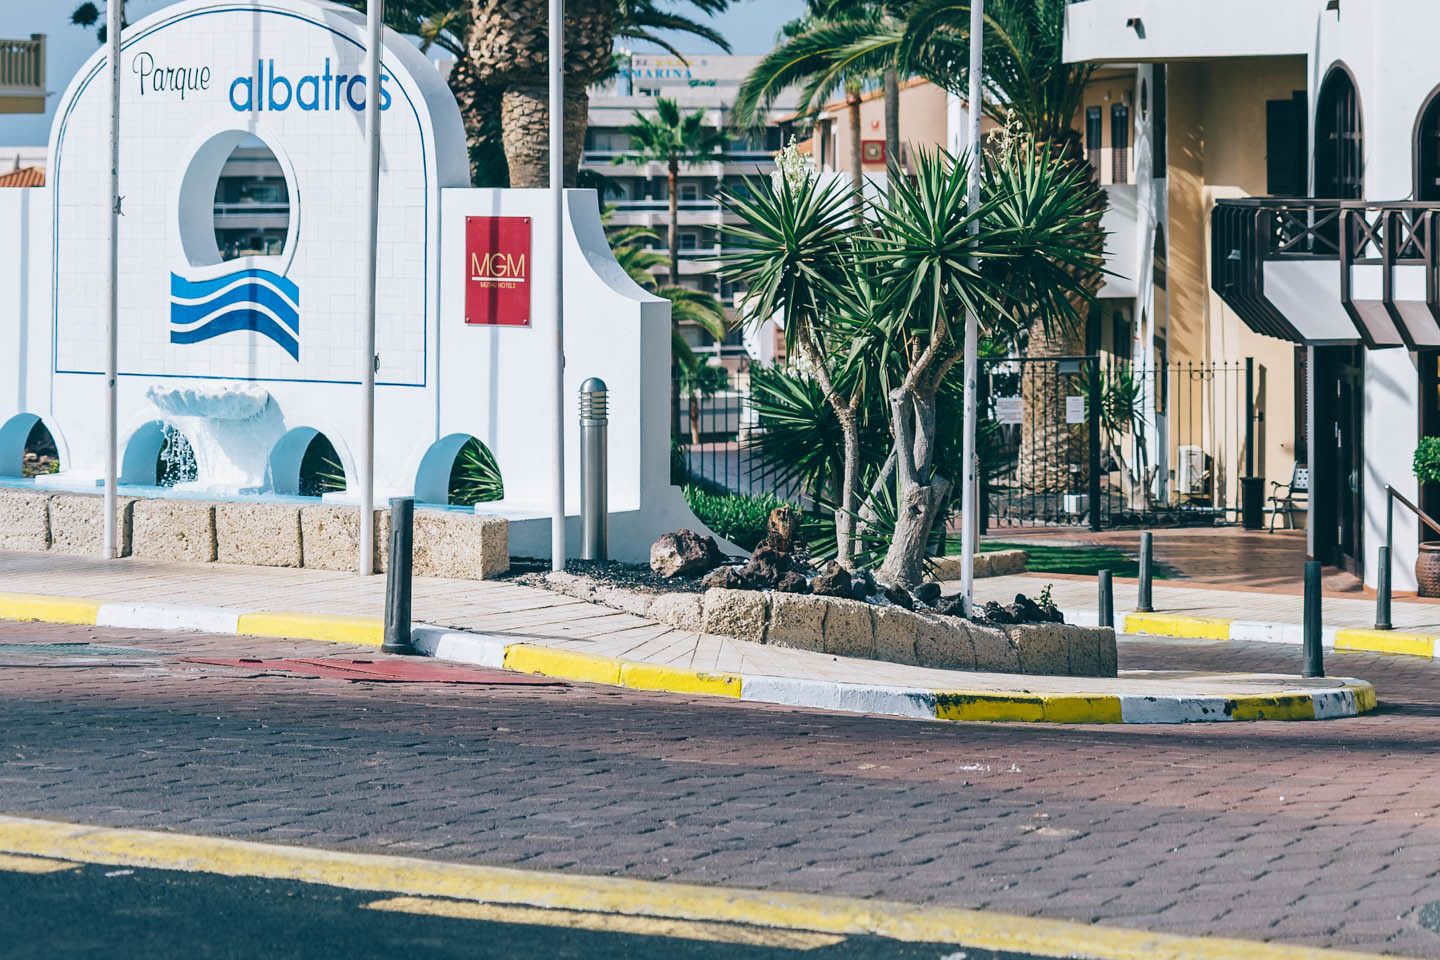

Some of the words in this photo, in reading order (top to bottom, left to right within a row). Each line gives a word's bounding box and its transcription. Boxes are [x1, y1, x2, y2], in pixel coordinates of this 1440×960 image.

[132, 51, 211, 101] Parque
[229, 57, 392, 112] albatros
[471, 252, 525, 277] MGM
